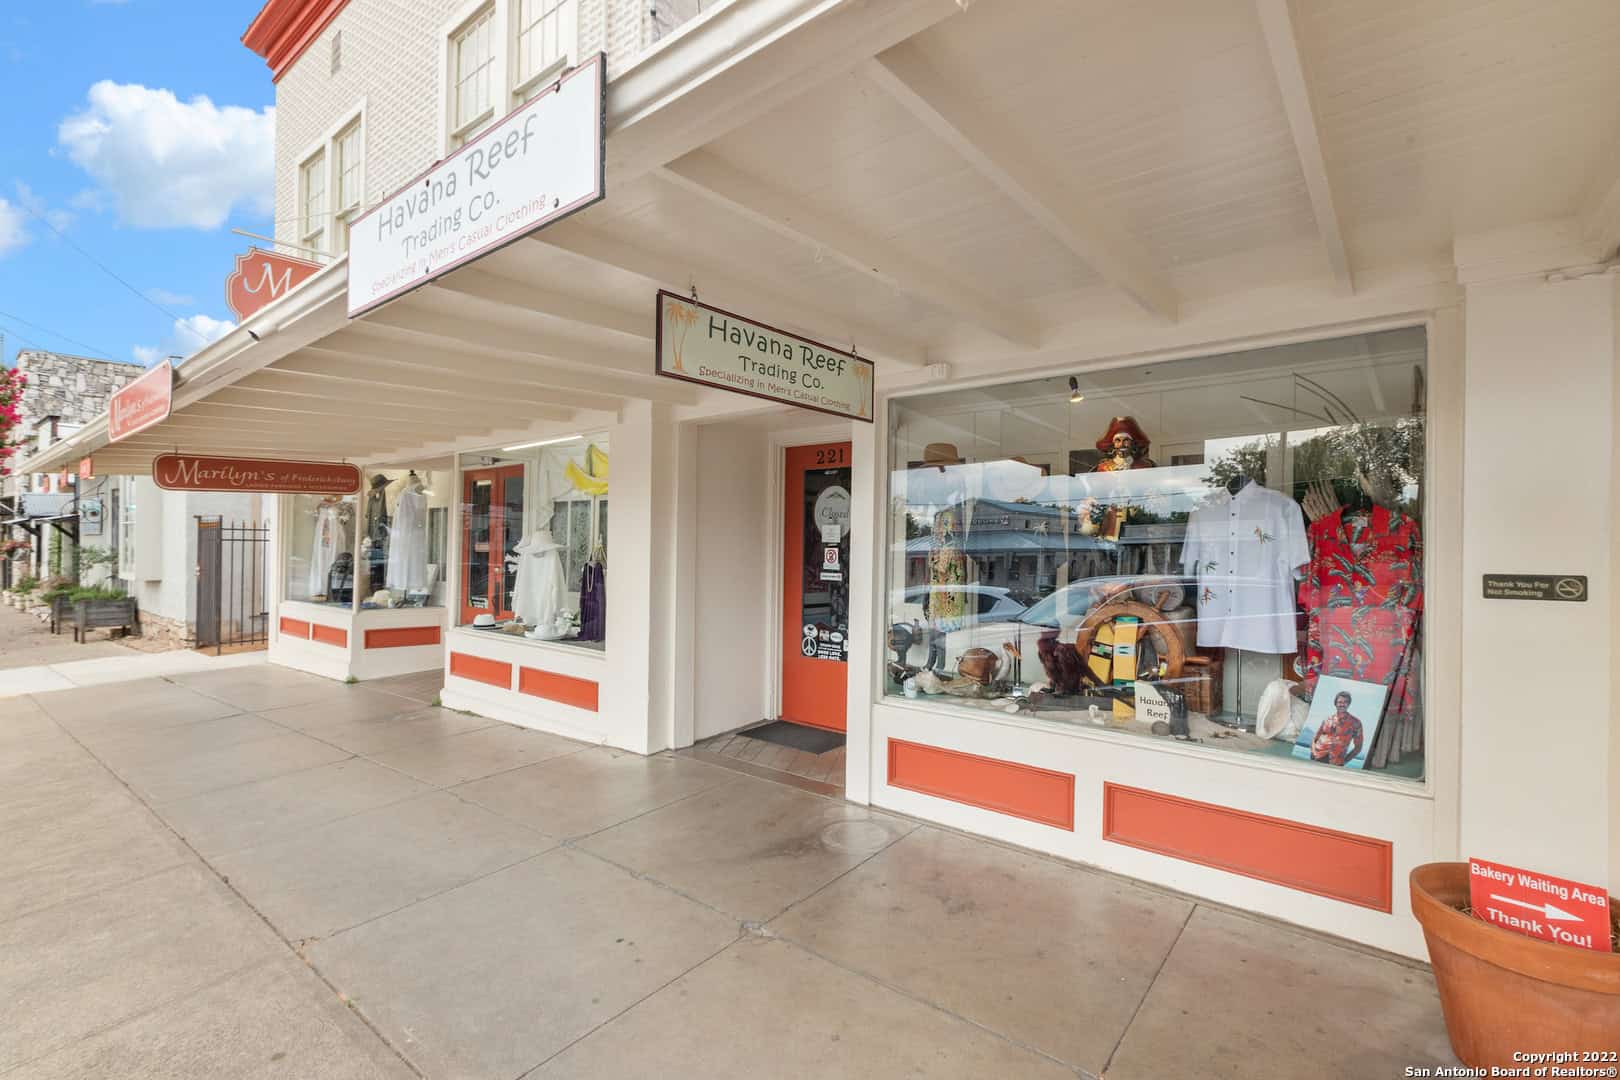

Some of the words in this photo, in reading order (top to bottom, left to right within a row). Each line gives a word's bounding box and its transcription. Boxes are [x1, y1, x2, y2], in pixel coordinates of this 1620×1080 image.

[378, 172, 457, 242] Havana
[465, 113, 538, 187] Reef
[402, 206, 462, 258] Trading
[468, 191, 501, 223] Co.
[458, 224, 493, 251] Casual
[495, 194, 547, 232] Clothing
[708, 315, 793, 361] Havana
[800, 345, 847, 377] Reef
[698, 366, 755, 387] Specializing
[756, 381, 765, 390] in
[738, 355, 798, 384] Trading
[801, 373, 825, 390] Co.
[164, 460, 276, 487] Marilyn's
[816, 448, 844, 465] 221
[1487, 580, 1515, 588] Thank
[1516, 581, 1533, 589] You
[1534, 581, 1549, 589] For
[1487, 588, 1503, 596] Not
[1504, 588, 1544, 598] Smoking
[1146, 708, 1169, 721] Reef
[1471, 863, 1515, 886] Bakery
[1517, 873, 1569, 900] Waiting
[1571, 888, 1607, 907] Area
[1487, 907, 1544, 935] Thank
[1548, 924, 1593, 948] You!
